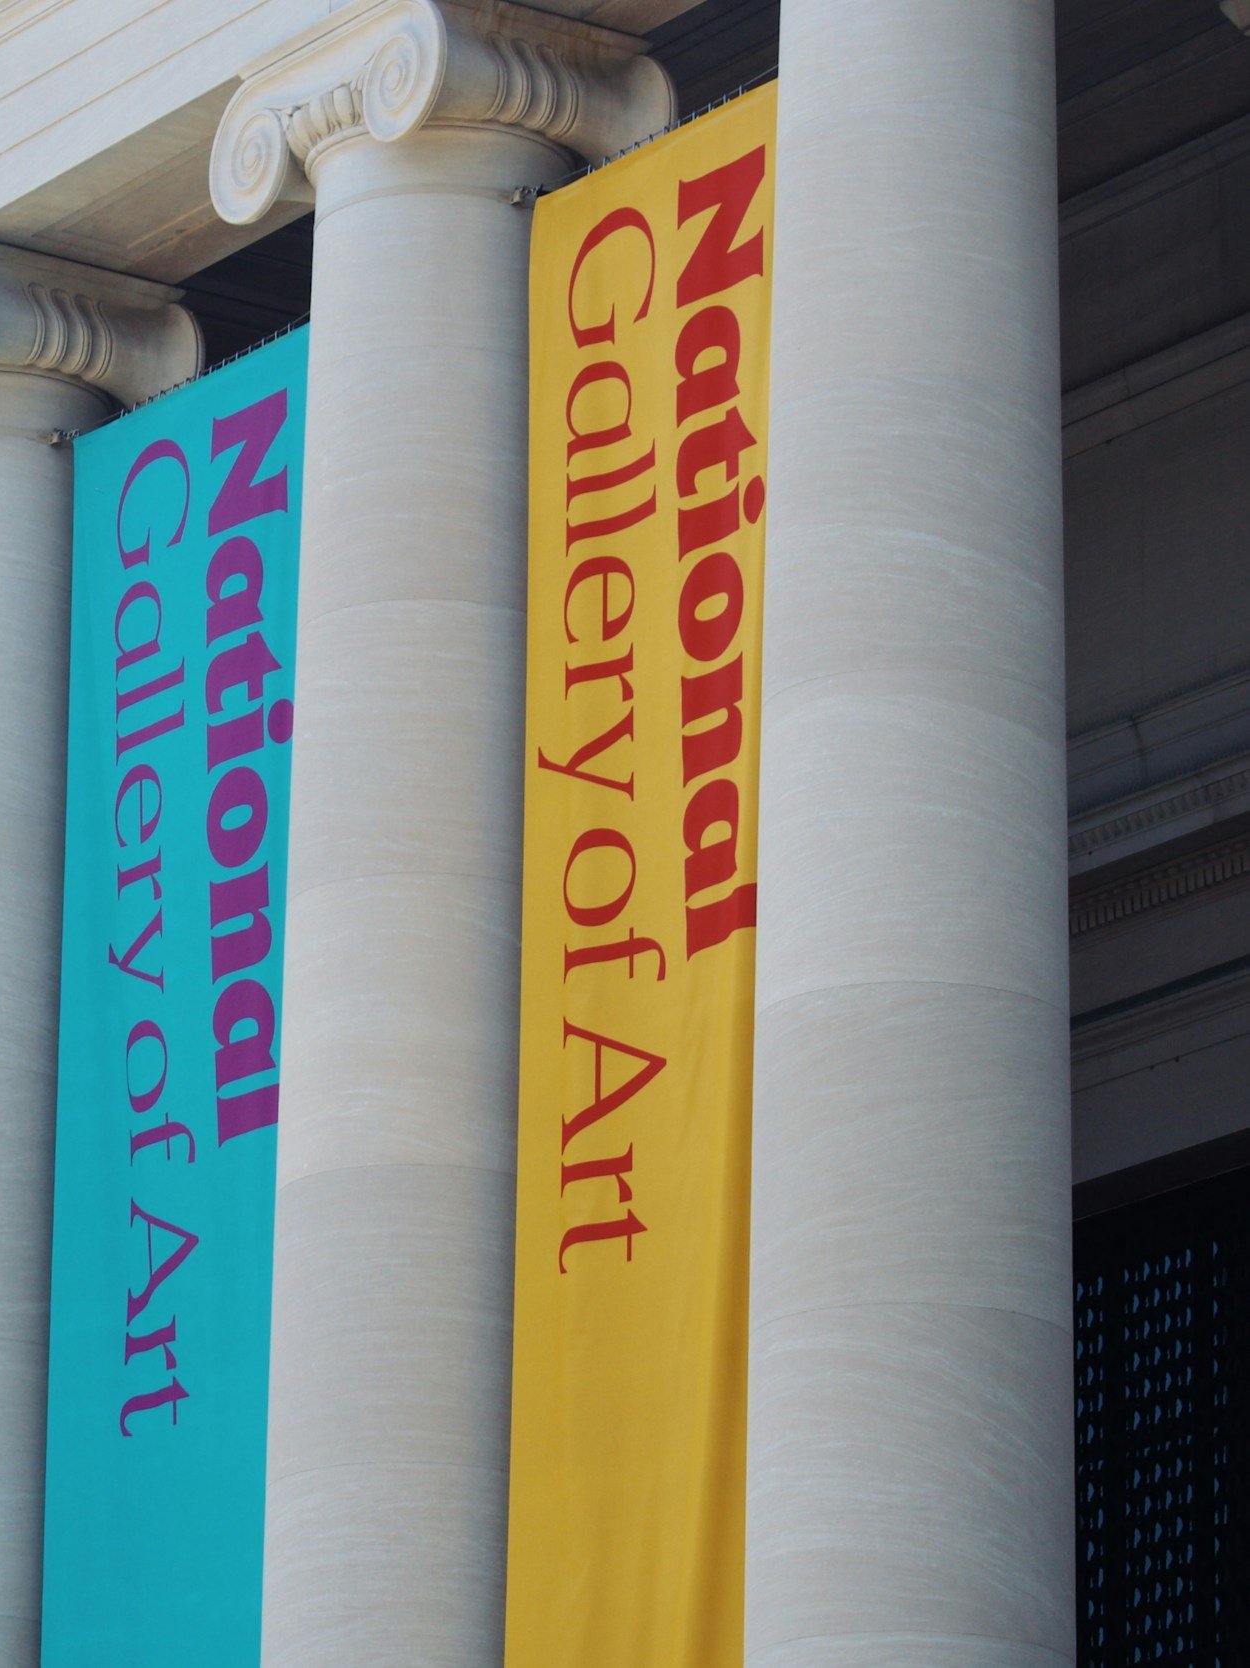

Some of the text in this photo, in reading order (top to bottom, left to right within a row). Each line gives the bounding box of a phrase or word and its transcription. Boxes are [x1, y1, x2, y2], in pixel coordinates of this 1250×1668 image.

[109, 438, 199, 1437] Gallery of Art
[206, 386, 295, 1147] National
[538, 206, 667, 1275] Gallery of Art
[675, 143, 766, 961] National
